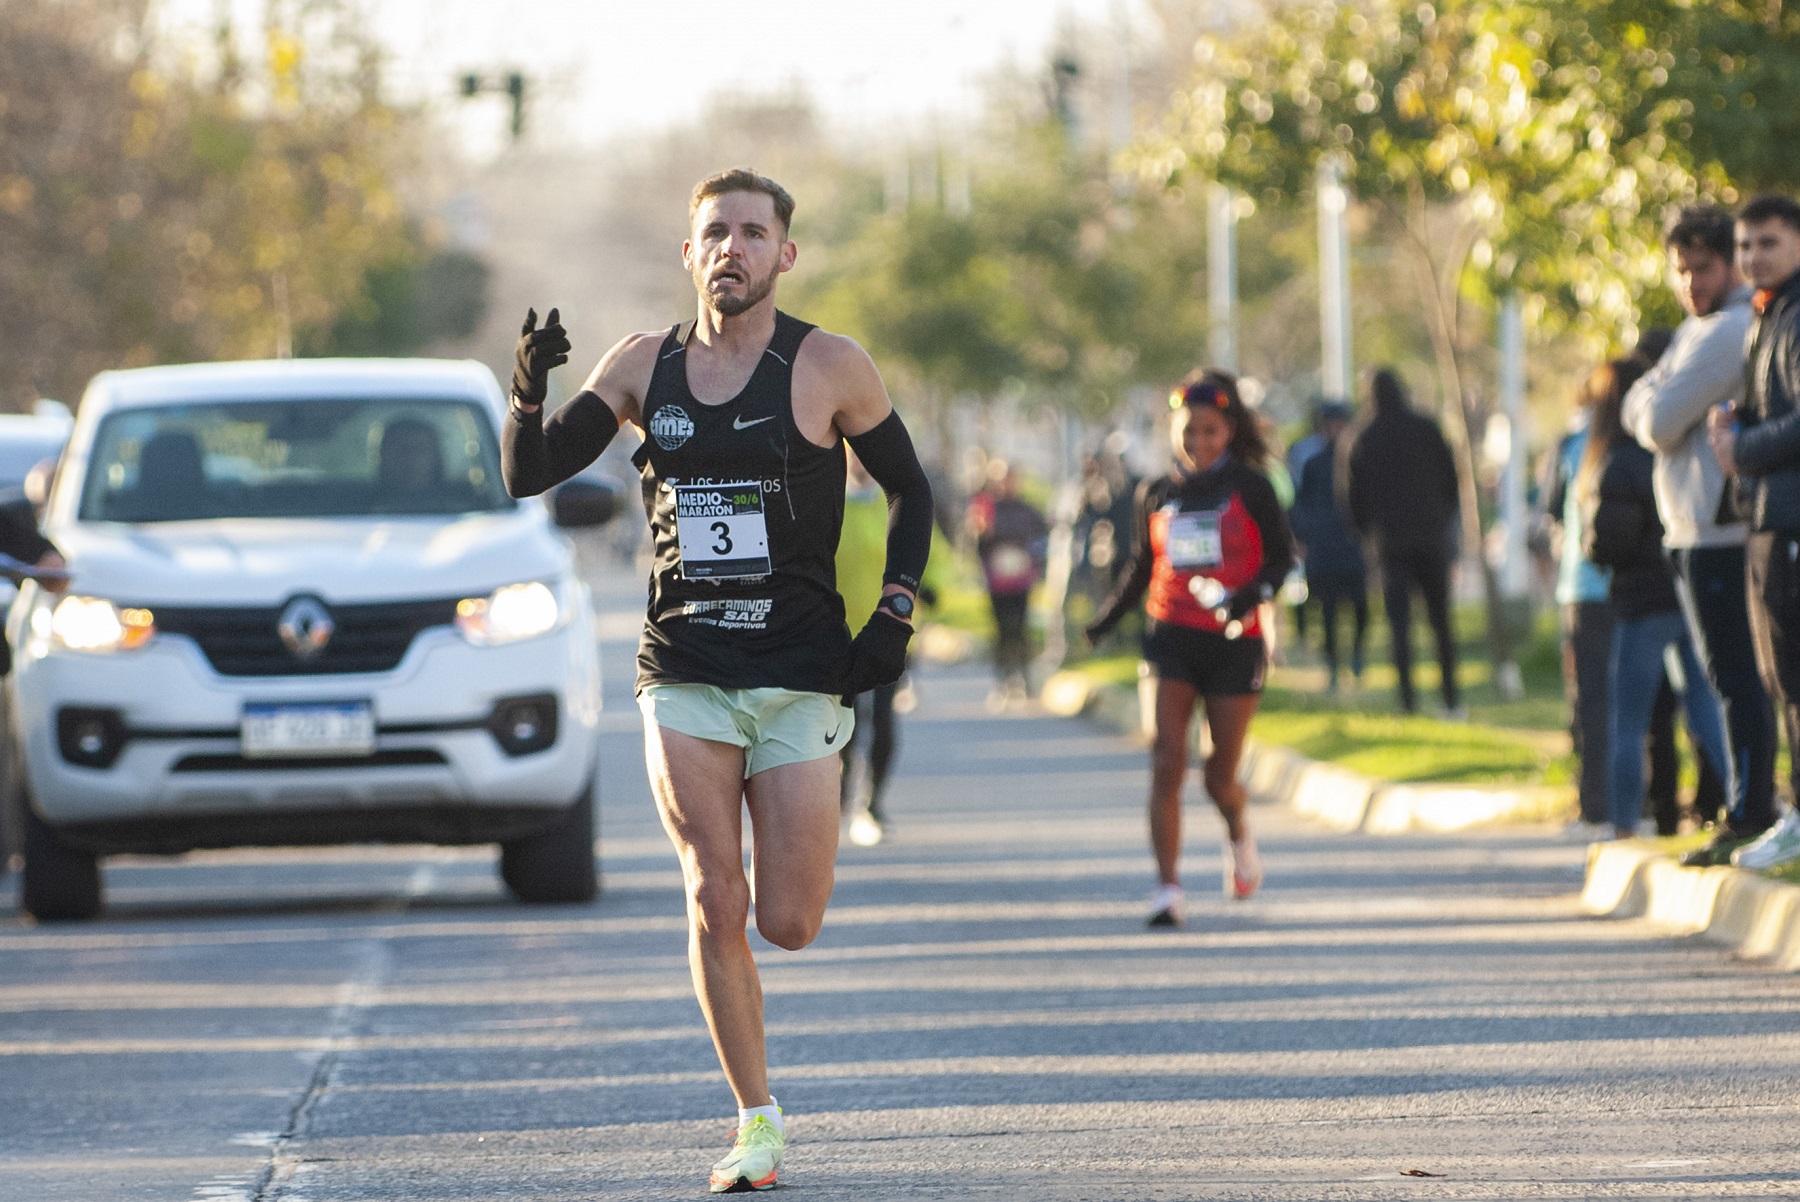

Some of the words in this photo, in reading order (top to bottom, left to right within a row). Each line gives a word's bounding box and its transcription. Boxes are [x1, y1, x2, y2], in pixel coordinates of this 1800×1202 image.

[678, 492, 722, 506] MEDIO
[733, 493, 759, 505] 30/6
[678, 505, 733, 517] MARATON
[710, 521, 733, 555] 3
[723, 611, 766, 621] SAG
[718, 620, 767, 630] Deportivos
